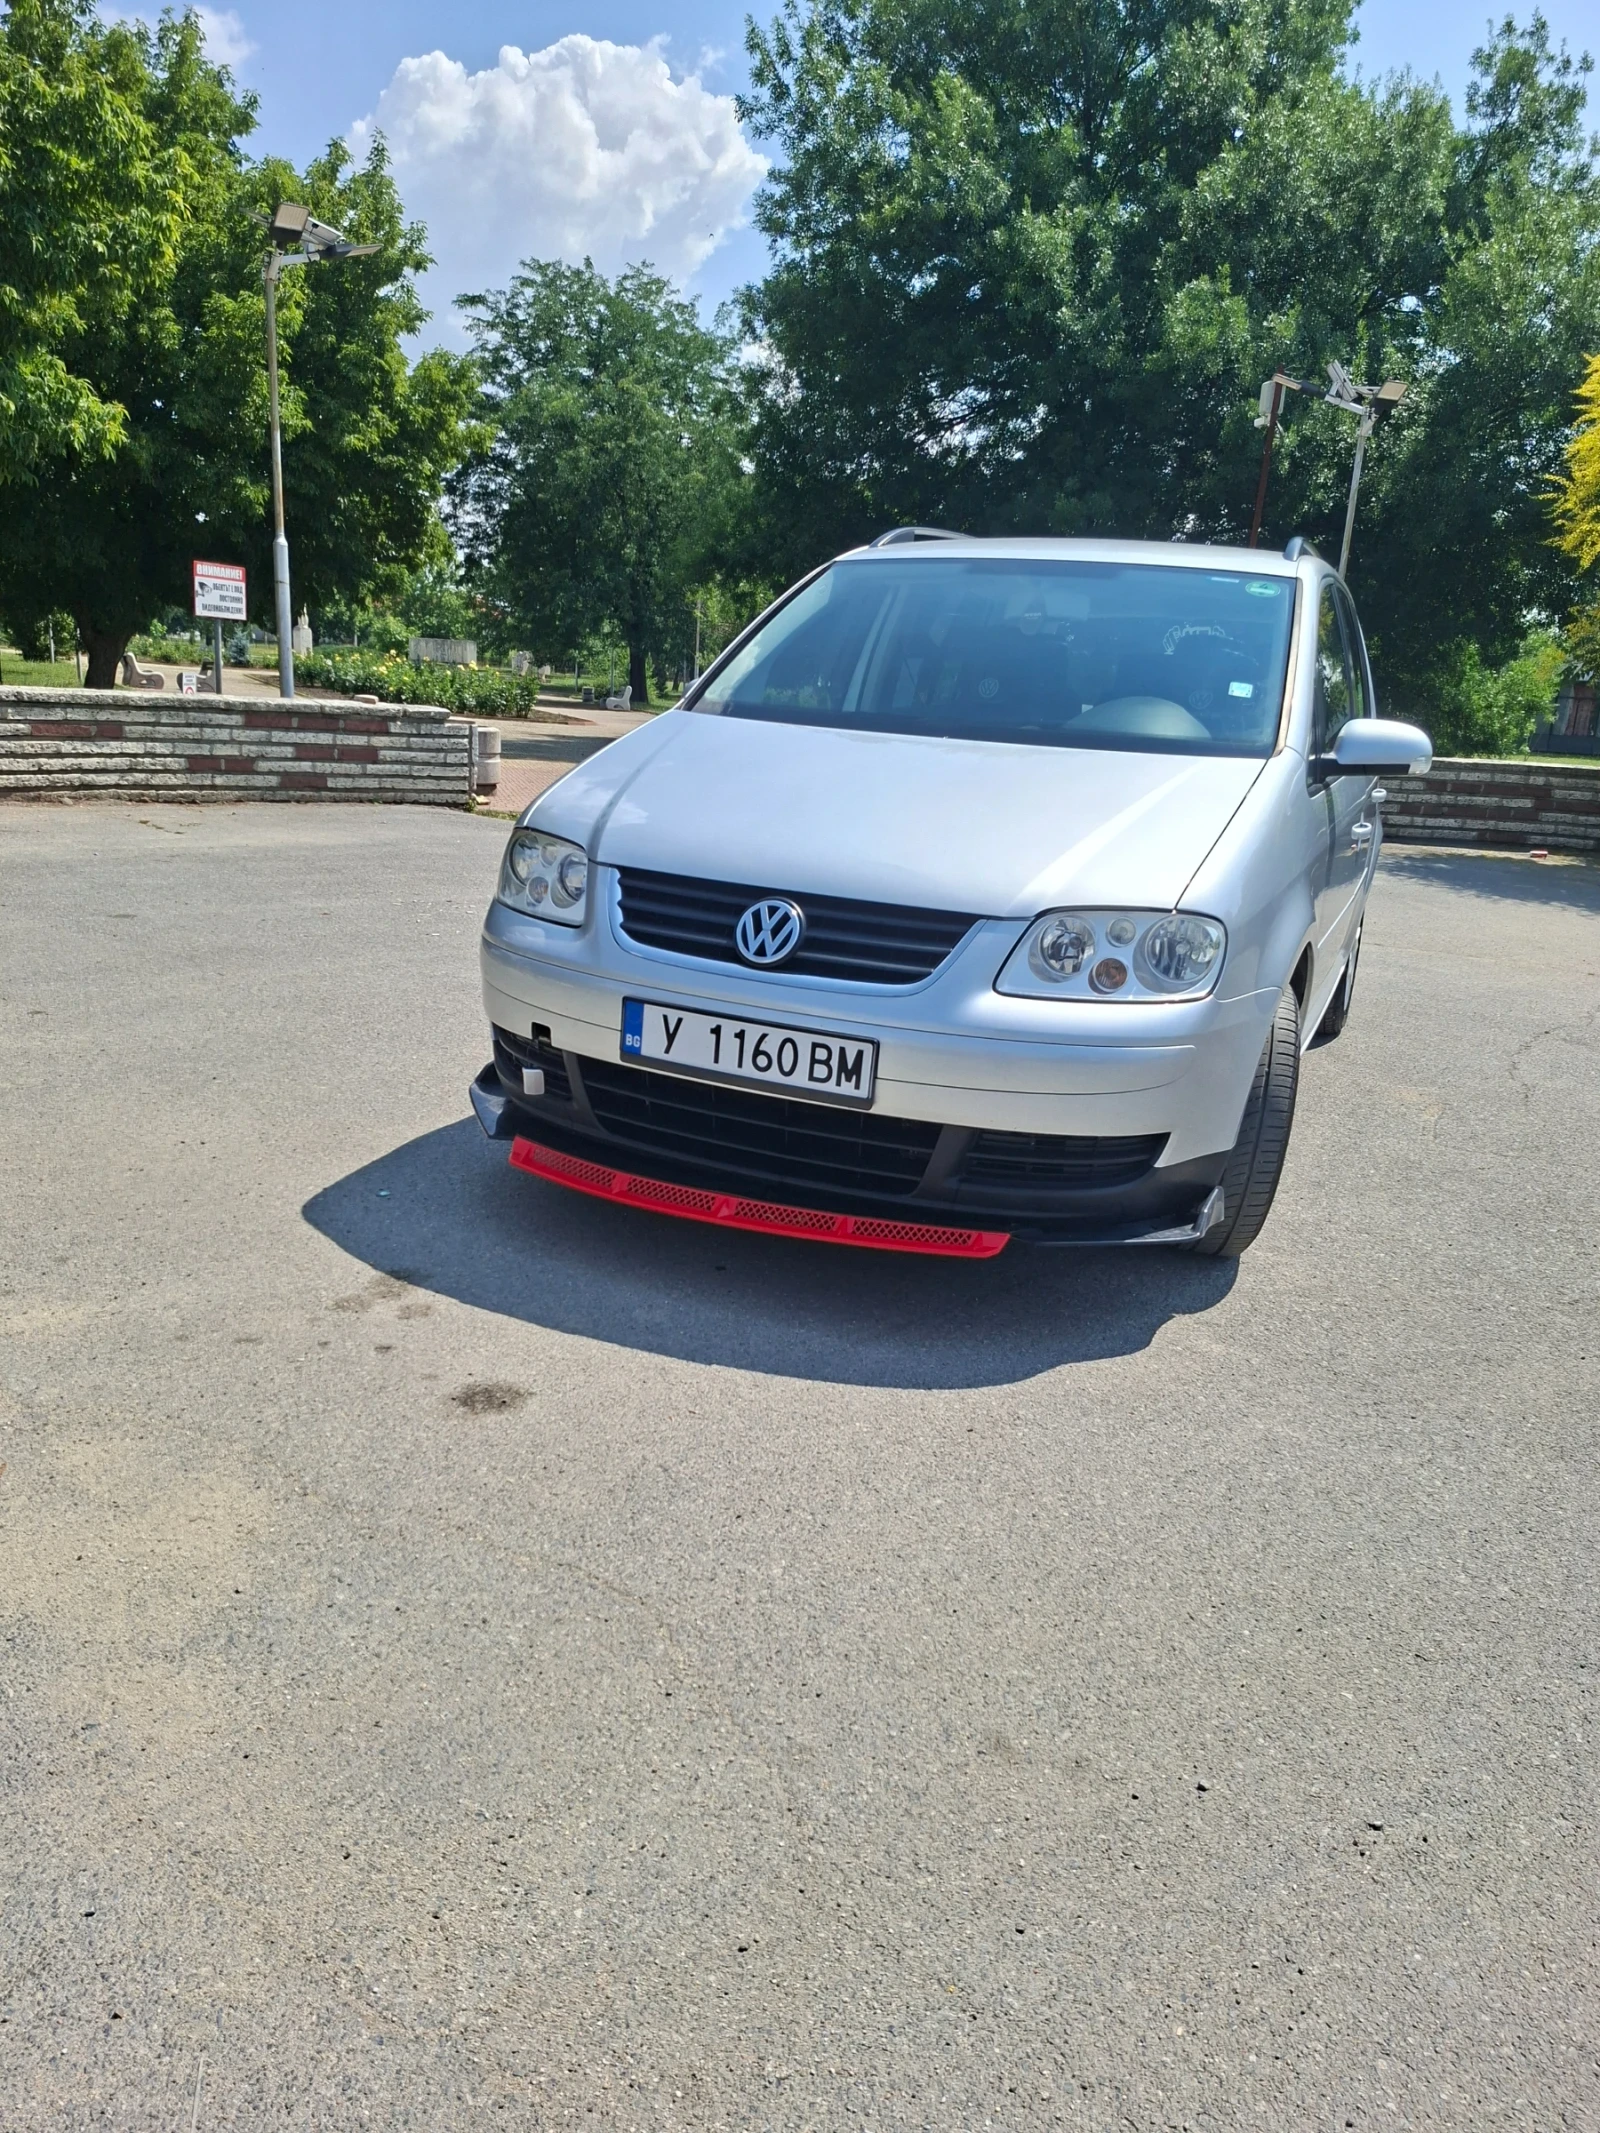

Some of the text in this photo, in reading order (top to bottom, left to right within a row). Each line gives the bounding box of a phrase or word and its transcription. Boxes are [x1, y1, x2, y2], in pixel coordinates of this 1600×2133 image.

[196, 563, 243, 580] ВНИМАНИЕ!
[736, 900, 800, 964] VW
[625, 1034, 640, 1048] BG
